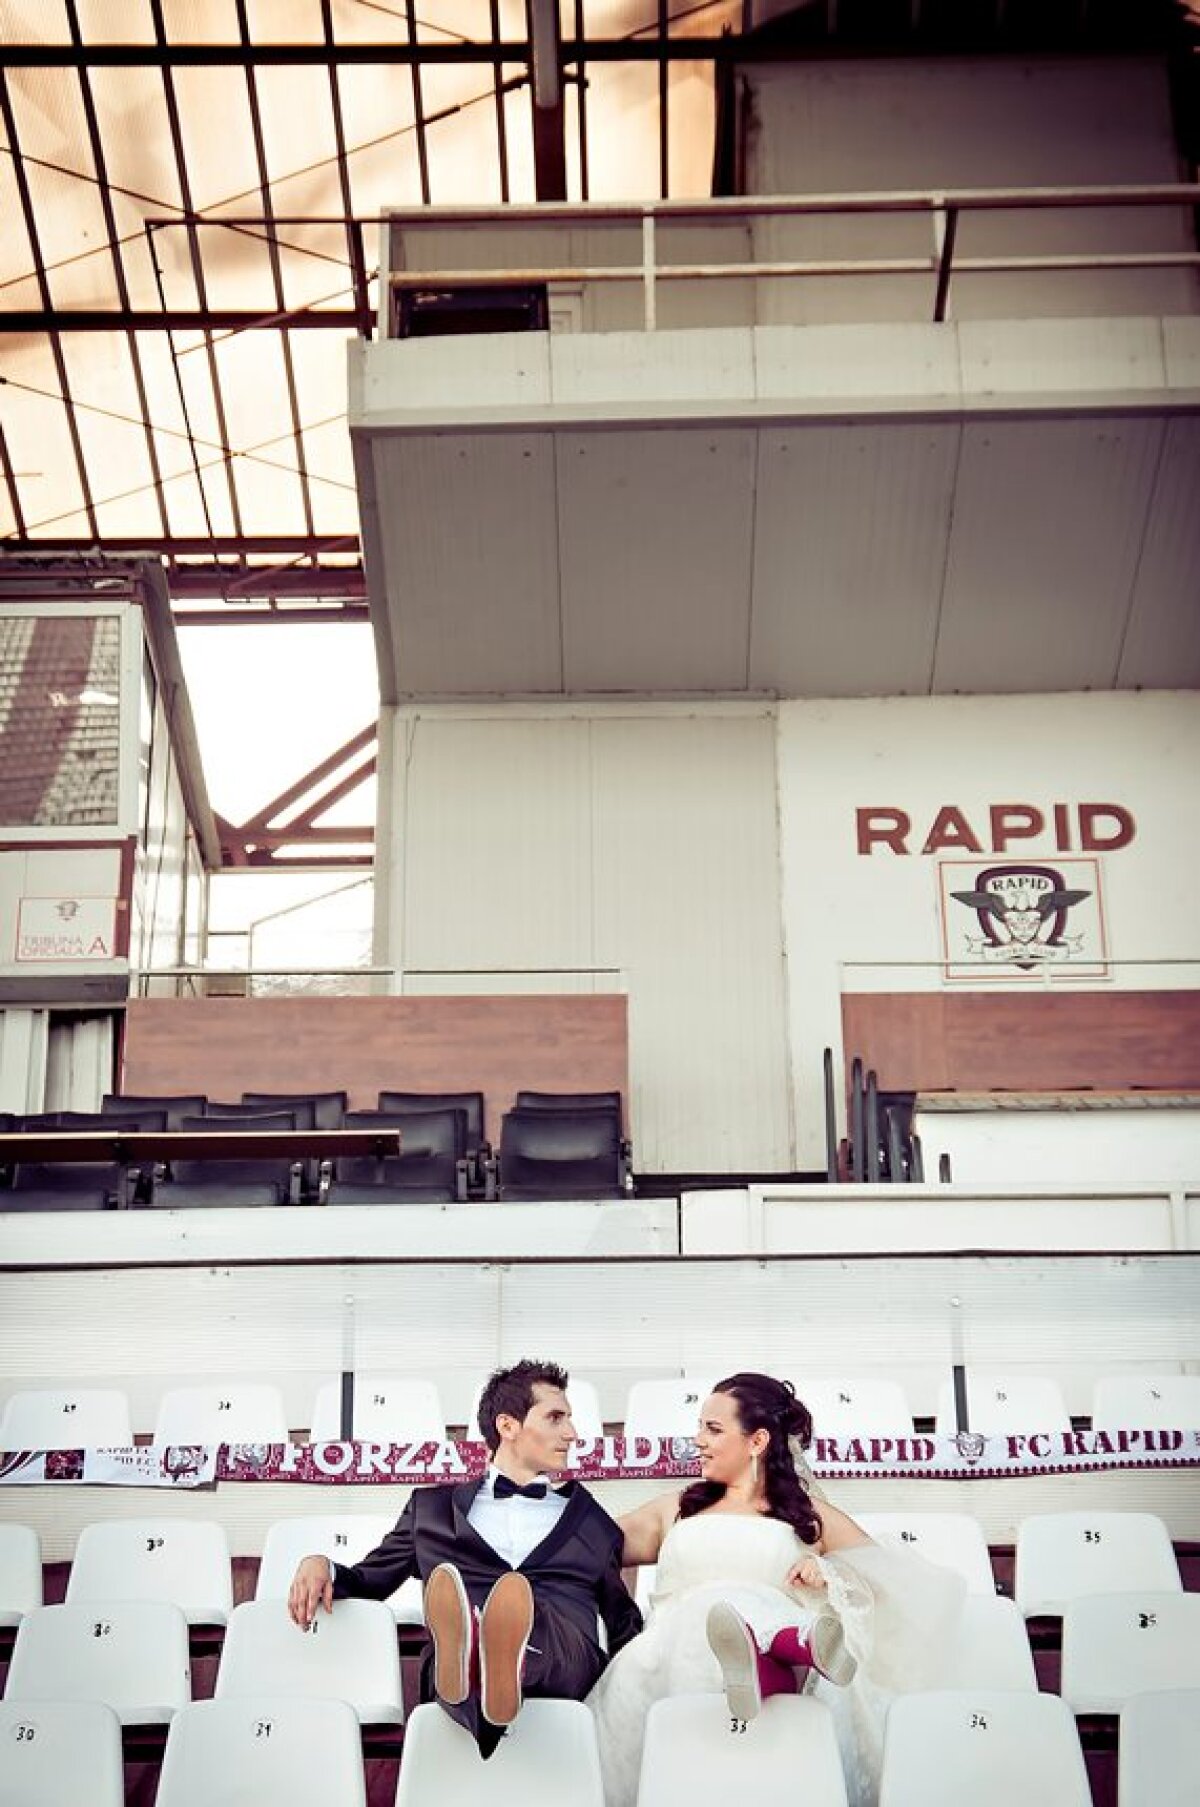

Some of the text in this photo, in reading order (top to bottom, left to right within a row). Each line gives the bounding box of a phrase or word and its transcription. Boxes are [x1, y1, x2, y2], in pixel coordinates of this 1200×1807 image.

[856, 803, 1136, 855] RAPID
[991, 877, 1049, 891] RAPID
[88, 936, 108, 955] A
[567, 1436, 661, 1469] PID
[815, 1438, 936, 1463] RAPID
[1006, 1434, 1051, 1458] FC
[1061, 1430, 1184, 1456] RAPID
[279, 1442, 468, 1475] FORZA
[1084, 1530, 1101, 1544] 35
[256, 1722, 272, 1738] 31
[730, 1718, 747, 1734] 33
[970, 1714, 988, 1731] 34
[16, 1726, 34, 1741] 30
